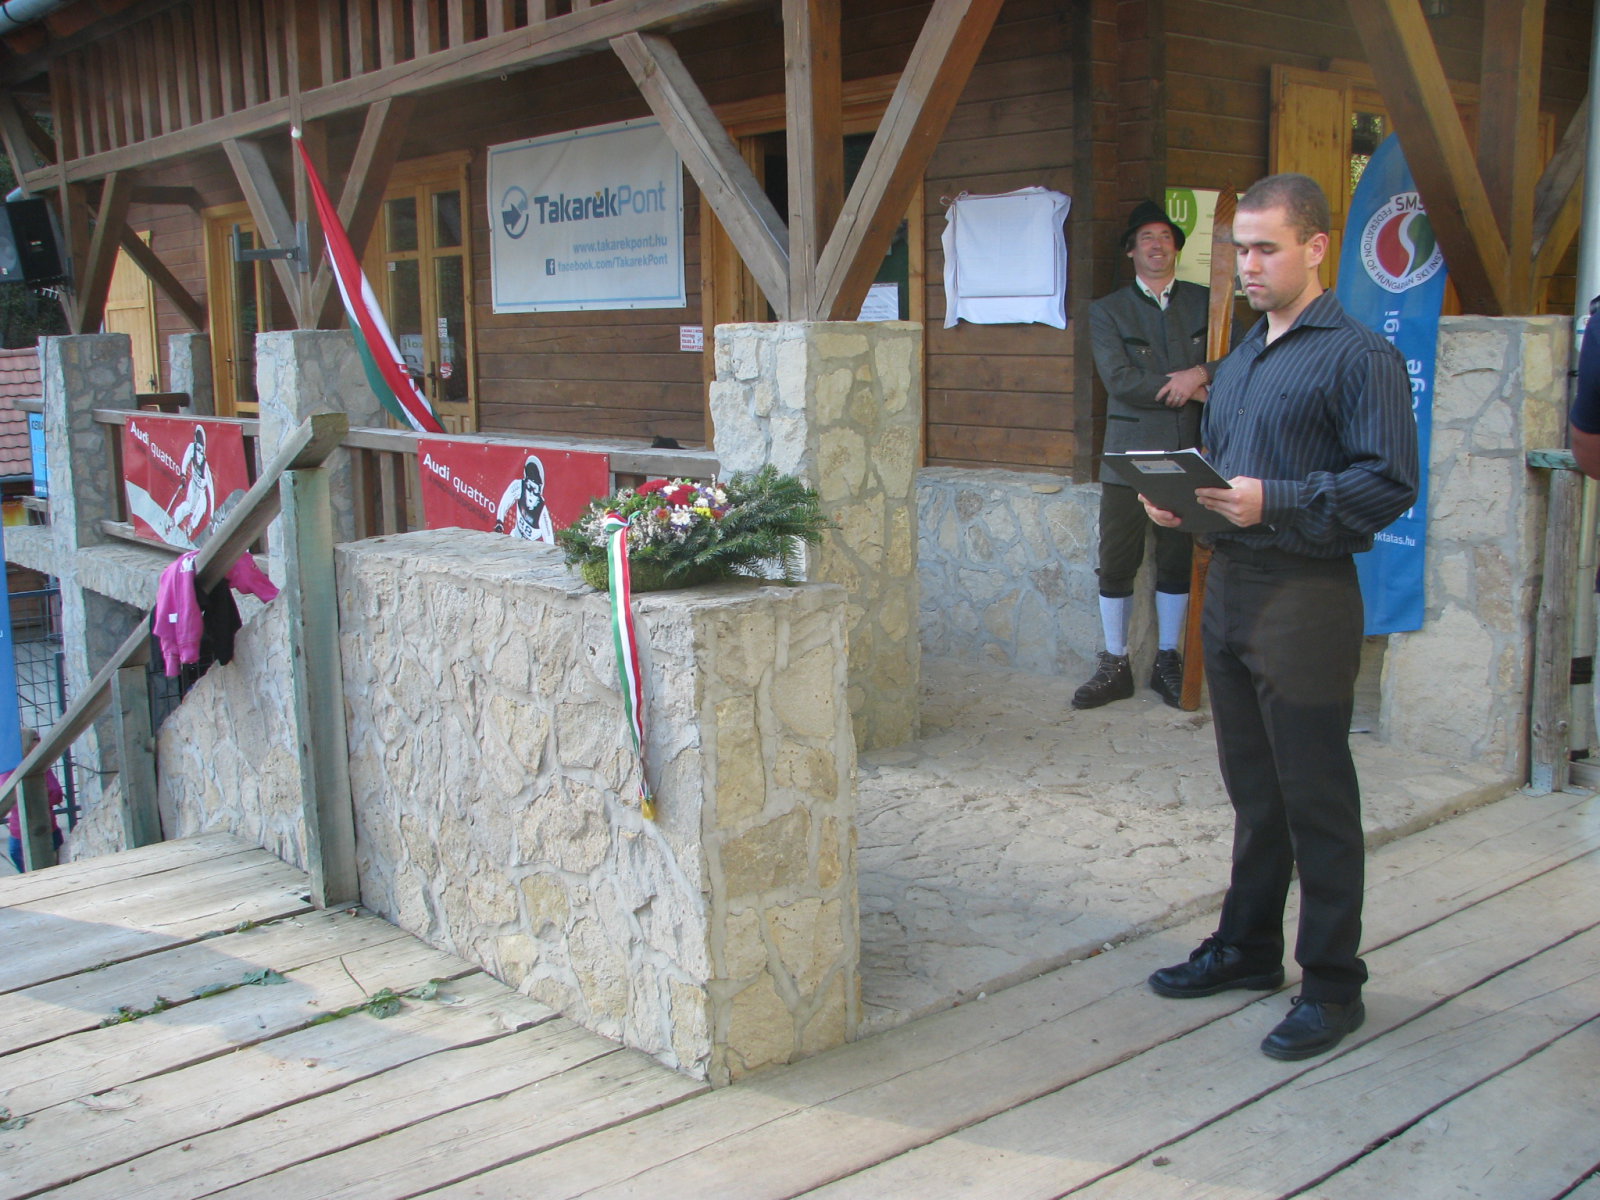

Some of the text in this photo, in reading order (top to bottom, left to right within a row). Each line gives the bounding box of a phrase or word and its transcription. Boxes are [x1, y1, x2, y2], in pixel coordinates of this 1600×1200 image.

[1363, 207, 1393, 258] FEDERATION
[572, 234, 668, 254] www.takarekpont.hu
[557, 254, 669, 273] facebook.com/TakarekPont
[1366, 259, 1377, 272] OF
[1374, 271, 1414, 290] HUNGARIAN
[1415, 268, 1430, 282] SKI
[130, 421, 150, 447] Audi
[150, 442, 182, 477] quattro
[423, 453, 450, 481] Audi
[452, 475, 496, 514] quattro
